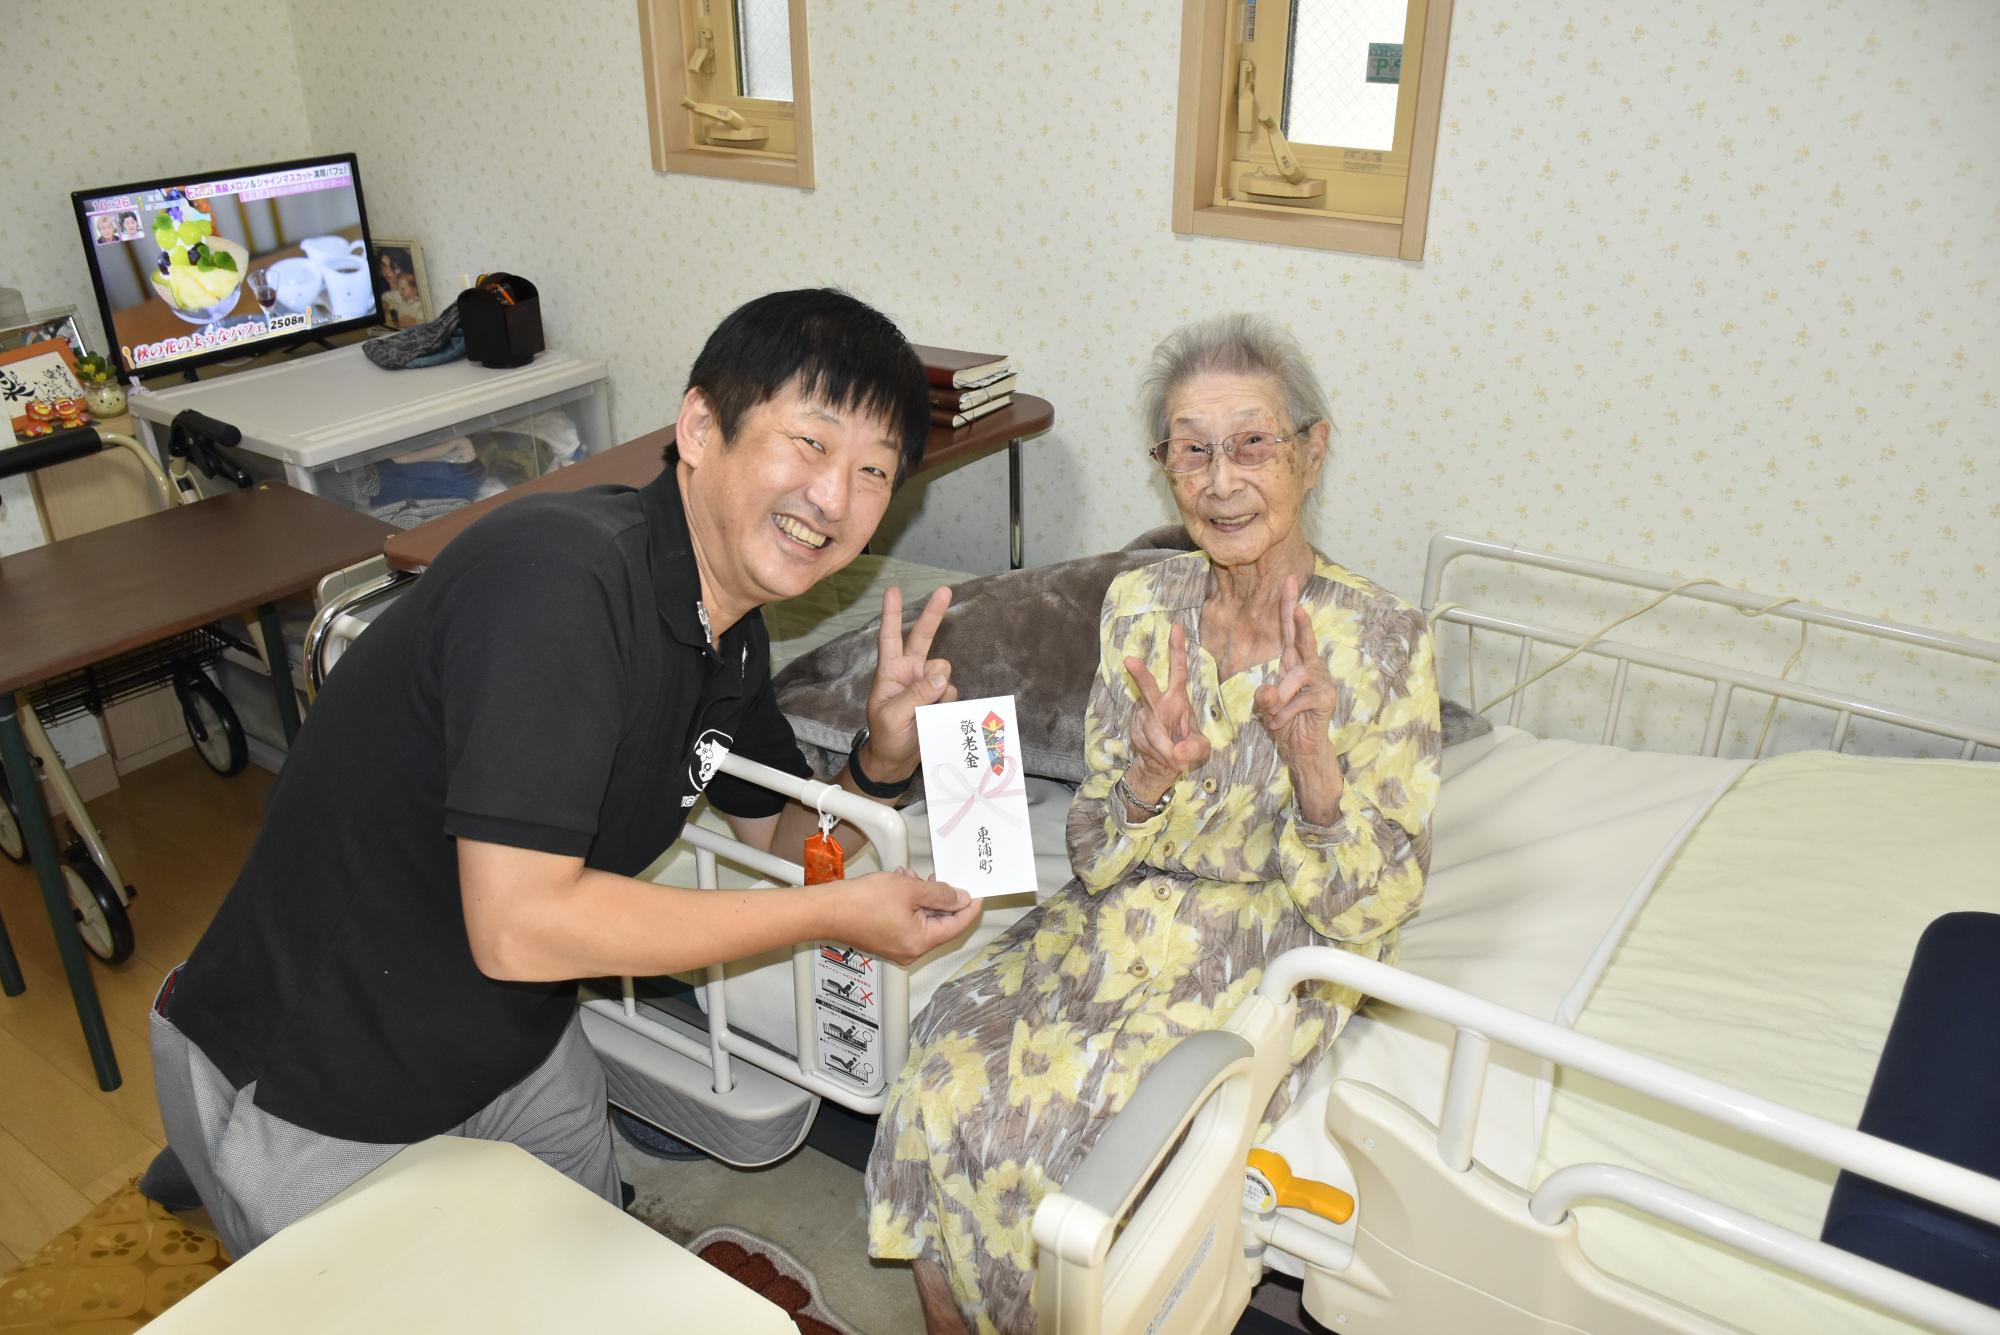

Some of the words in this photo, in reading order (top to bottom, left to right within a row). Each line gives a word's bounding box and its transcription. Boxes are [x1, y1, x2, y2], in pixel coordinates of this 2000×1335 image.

[960, 719, 979, 769] 敬老金
[977, 826, 993, 875] 東浦町
